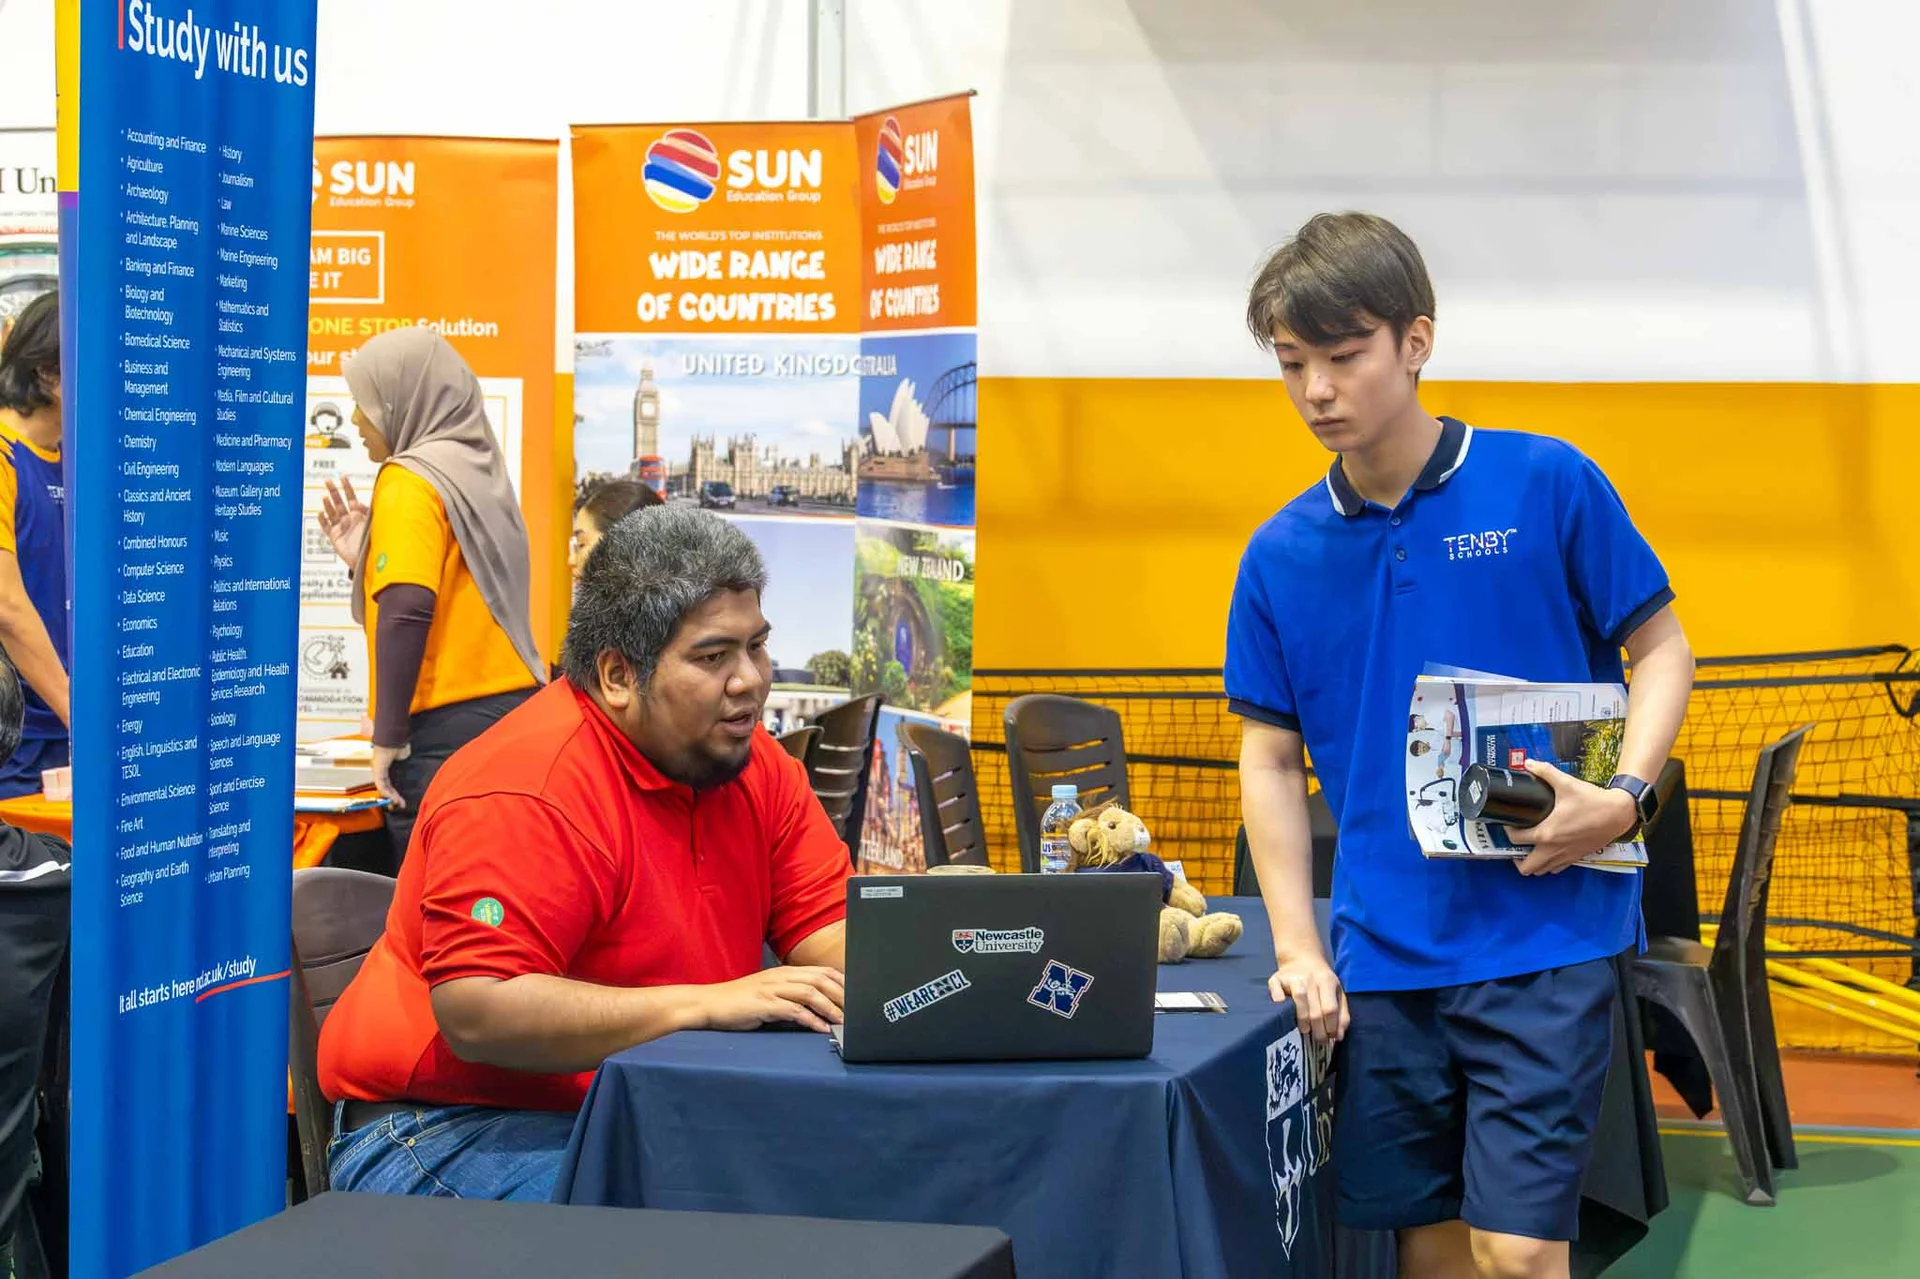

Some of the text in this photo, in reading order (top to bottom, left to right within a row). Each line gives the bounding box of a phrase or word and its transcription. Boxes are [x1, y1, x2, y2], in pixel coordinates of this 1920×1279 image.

[128, 0, 309, 87] Study with us
[126, 128, 206, 153] Accounting and Finance
[222, 145, 243, 163] History
[904, 130, 938, 176] SUN
[127, 155, 163, 173] Agriculture
[727, 149, 823, 188] SUN
[222, 172, 253, 188] Journalism
[330, 161, 416, 196] SUN
[126, 183, 168, 204] Archaeology
[727, 190, 821, 203] Education Group
[221, 198, 232, 210] Law
[330, 197, 415, 209] Education Group
[169, 215, 199, 235] Planning
[240, 225, 268, 241] Sciences
[126, 232, 178, 250] and Landscape
[655, 230, 675, 240] THE
[729, 230, 750, 240] TOP
[752, 230, 823, 240] INSTITUTIONS
[239, 250, 278, 270] Engineering
[337, 247, 371, 266] BIG
[649, 249, 826, 280] WIDE RANGE
[874, 239, 937, 275] WIDE RANGE
[126, 258, 195, 277] Banking and Finance
[219, 274, 248, 292] Marketing
[323, 271, 343, 289] IT
[125, 285, 164, 303] Biology and
[869, 283, 940, 320] OF COUNTRIES
[218, 300, 269, 316] Mathematics and
[637, 291, 837, 322] OF COUNTRIES
[125, 305, 174, 325] Biotechnology
[218, 318, 243, 333] Statistics
[309, 316, 355, 335] ONE
[416, 317, 498, 337] Solution
[125, 332, 191, 349] Biomedical Science
[251, 348, 262, 359] and
[263, 347, 296, 363] Systems
[125, 360, 168, 375] Business and
[218, 363, 251, 380] Engineering
[682, 354, 765, 376] UNITED
[124, 380, 168, 398] Management
[235, 390, 293, 404] Film and Cultural
[124, 408, 197, 426] Chemical Engineering
[124, 434, 157, 452] Chemistry
[241, 435, 253, 447] and
[254, 435, 292, 450] Pharmacy
[124, 461, 179, 478] Civil Engineering
[237, 460, 274, 475] Languages
[124, 488, 191, 502] Classics and Ancient
[240, 484, 280, 500] Gallery and
[124, 510, 145, 525] History
[238, 503, 262, 516] Studies
[123, 535, 188, 550] Combined Honours
[214, 529, 229, 542] Music
[1449, 546, 1508, 560] SCHOOLS
[214, 554, 233, 570] Physics
[123, 562, 184, 579] Computer Science
[232, 579, 243, 591] and
[244, 577, 291, 591] International
[123, 590, 165, 604] Data Science
[122, 616, 158, 632] Economics
[212, 625, 243, 640] Psychology
[122, 645, 153, 659] Education
[122, 667, 201, 686] Electrical and Electronic
[248, 665, 262, 678] and
[264, 663, 289, 676] Health
[234, 683, 265, 697] Research
[122, 690, 160, 708] Engineering
[122, 719, 143, 734] Energy
[210, 712, 236, 727] Sociology
[146, 737, 197, 758] Linguistics and
[231, 737, 241, 750] and
[242, 732, 281, 748] Language
[122, 764, 141, 779] TESOL
[223, 780, 235, 792] and
[235, 776, 265, 790] Exercise
[121, 783, 195, 807] Environmental Science
[121, 817, 144, 833] Fine Art
[238, 820, 251, 832] and
[121, 832, 203, 860] Food and Human Nutrition
[121, 860, 190, 888] Geography and Earth
[224, 864, 250, 880] Planning
[120, 891, 144, 907] Science
[976, 929, 1042, 941] Newcastle
[975, 940, 1043, 951] University
[120, 995, 125, 1014] It
[125, 990, 137, 1011] all
[139, 983, 170, 1007] starts
[172, 980, 195, 999] here
